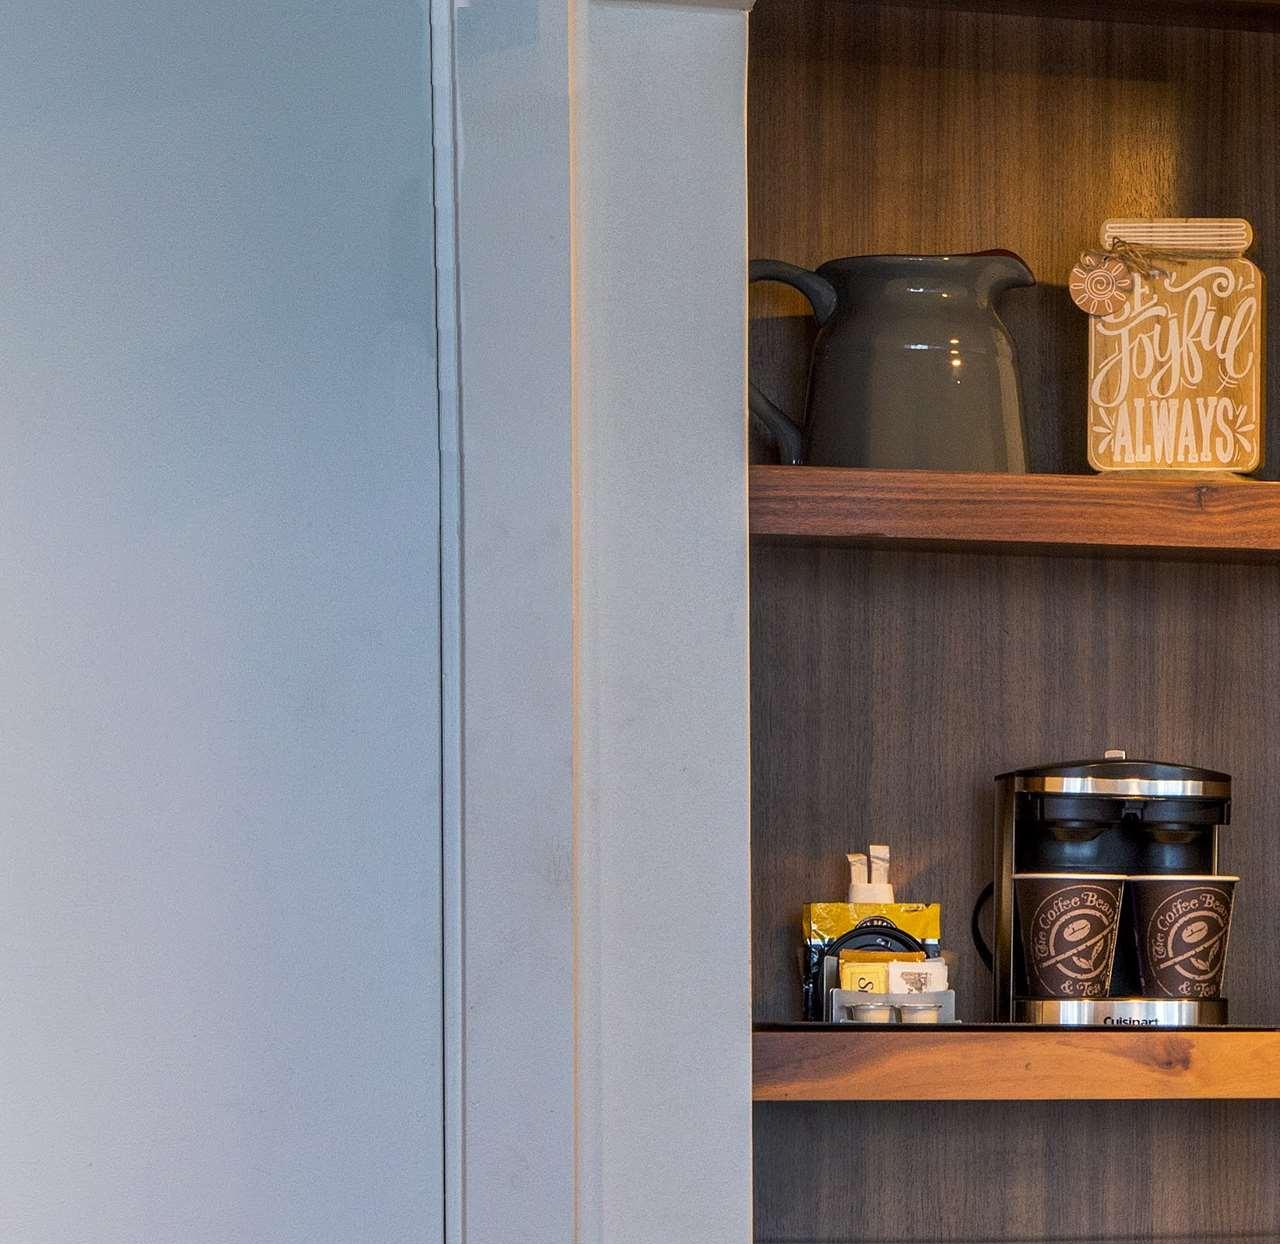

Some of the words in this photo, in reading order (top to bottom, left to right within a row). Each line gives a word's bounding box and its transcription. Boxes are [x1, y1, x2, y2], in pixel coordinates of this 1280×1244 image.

[1090, 286, 1257, 407] Joyful
[1112, 397, 1235, 465] ALWAYS
[1039, 896, 1080, 929] Coffee
[1081, 891, 1115, 920] Bean
[1157, 898, 1199, 931] Coffee
[1060, 980, 1073, 994] &
[1178, 981, 1192, 995] &
[1103, 1016, 1160, 1026] Cuisinart
